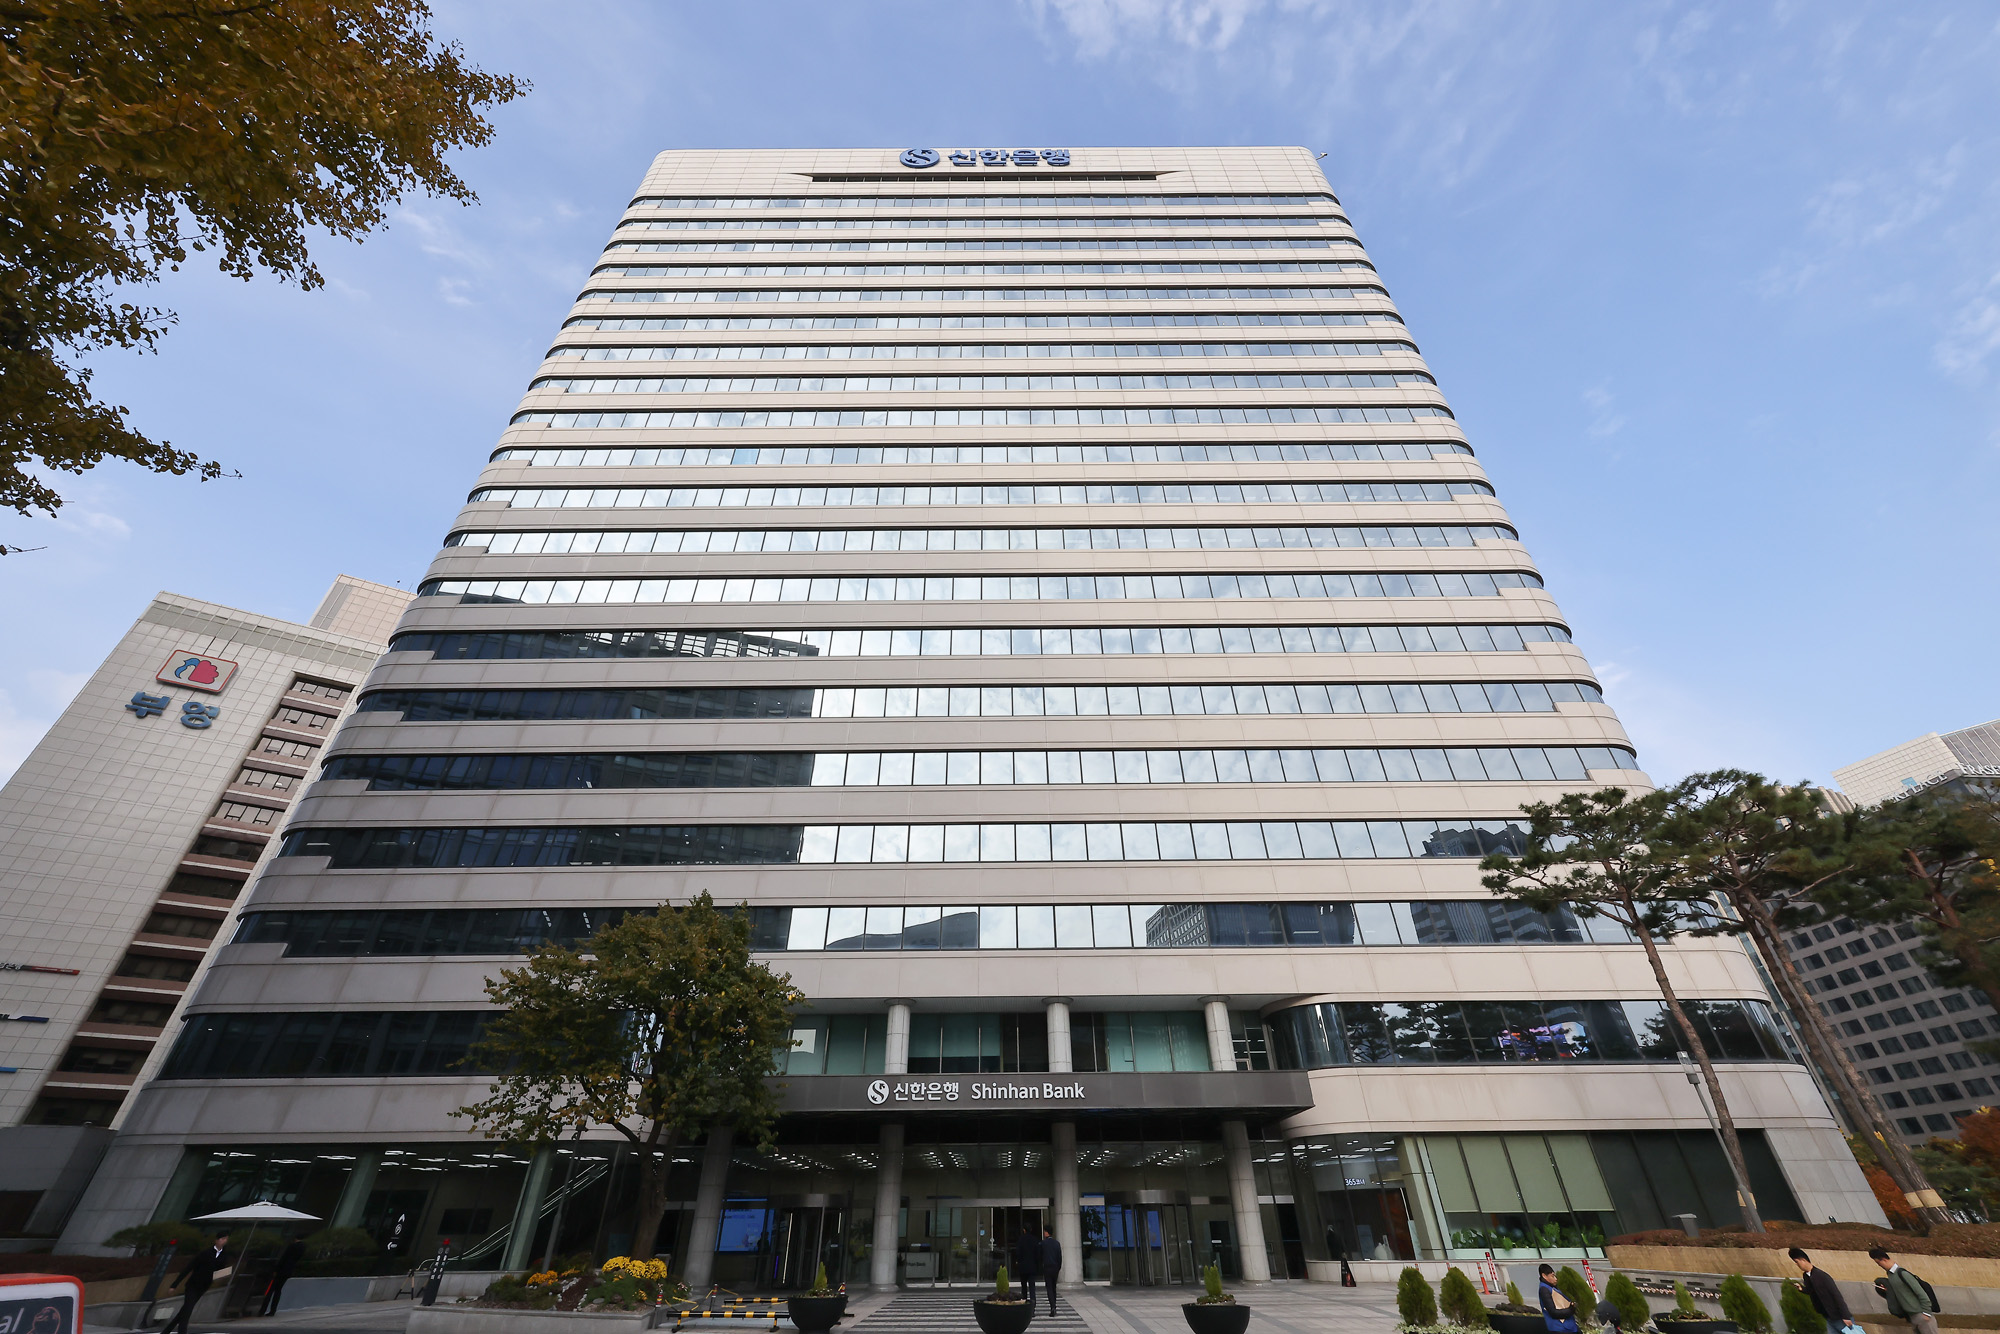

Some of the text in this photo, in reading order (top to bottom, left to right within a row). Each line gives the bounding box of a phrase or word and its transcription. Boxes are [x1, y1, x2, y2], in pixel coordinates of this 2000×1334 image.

[948, 149, 1071, 167] 신한은행
[125, 691, 220, 729] 부영
[893, 1082, 959, 1101] 신한은행
[971, 1082, 1086, 1100] Shinhan Bank
